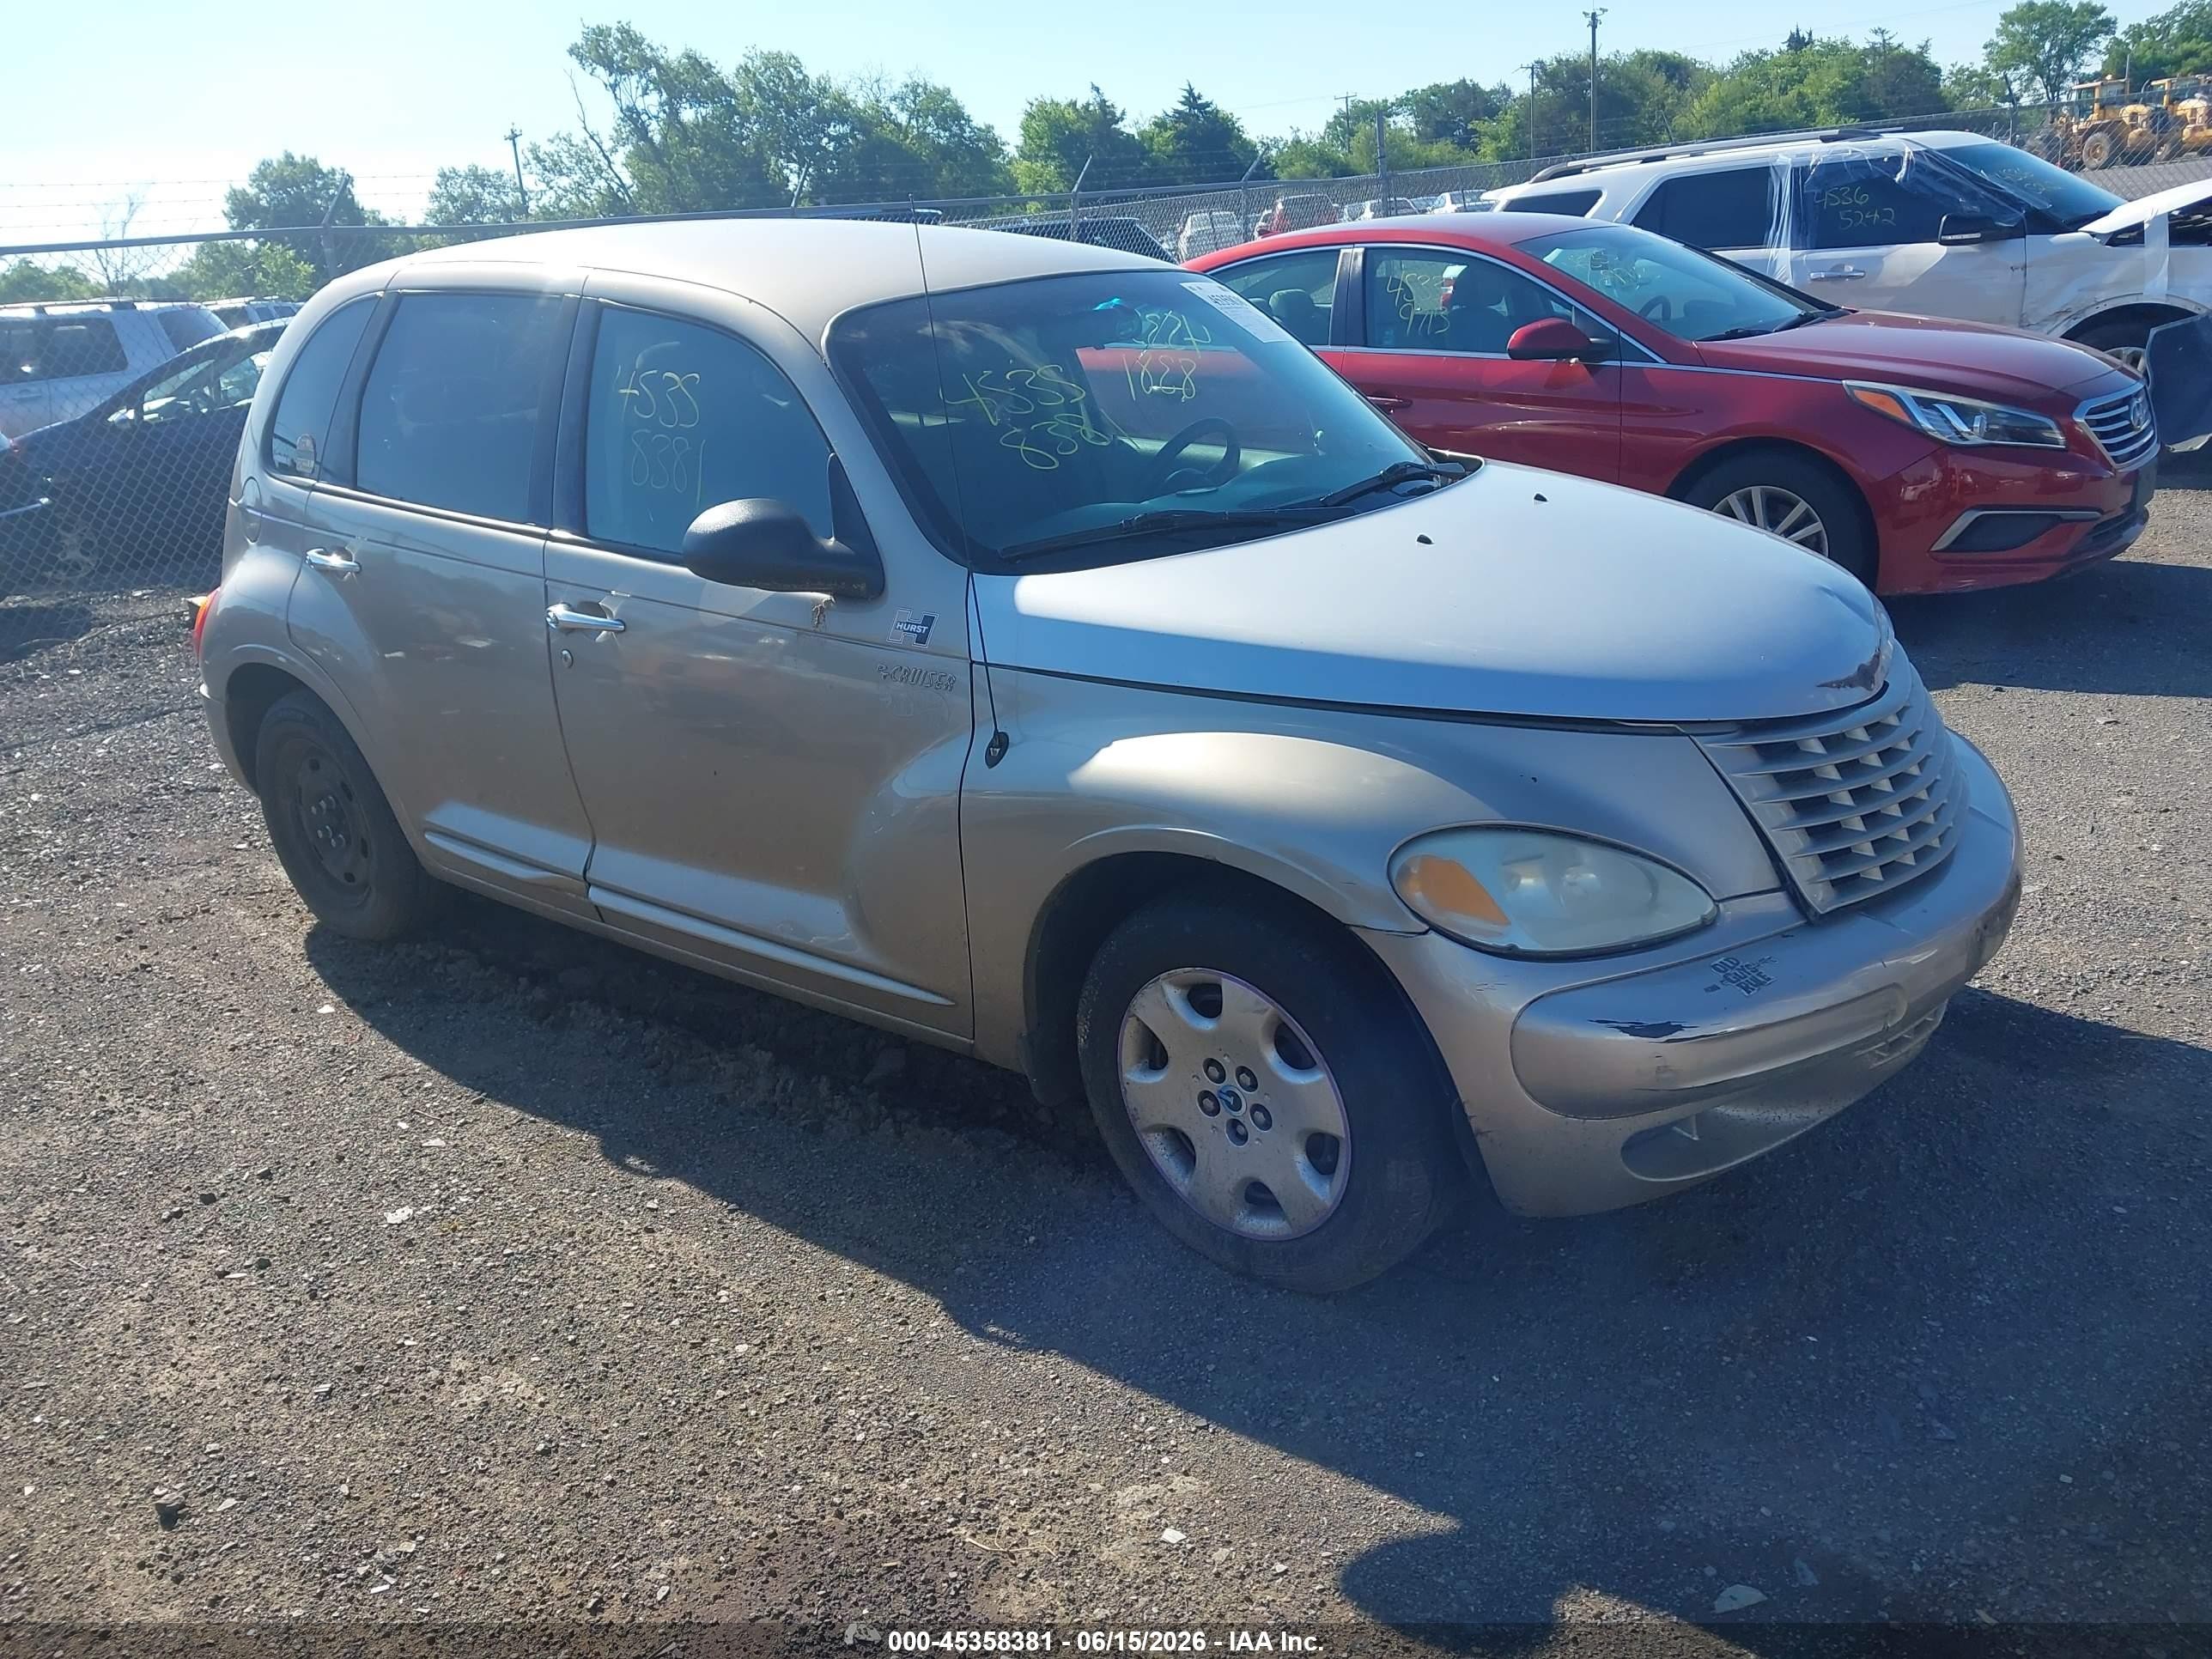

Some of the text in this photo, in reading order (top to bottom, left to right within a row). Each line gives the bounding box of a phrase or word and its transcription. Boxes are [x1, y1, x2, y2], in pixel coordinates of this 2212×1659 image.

[1814, 185, 1869, 210] 4536
[1839, 207, 1897, 230] 5242
[896, 622, 928, 634] HURST
[890, 665, 957, 691] CRUISER
[1735, 970, 1772, 994] RULE
